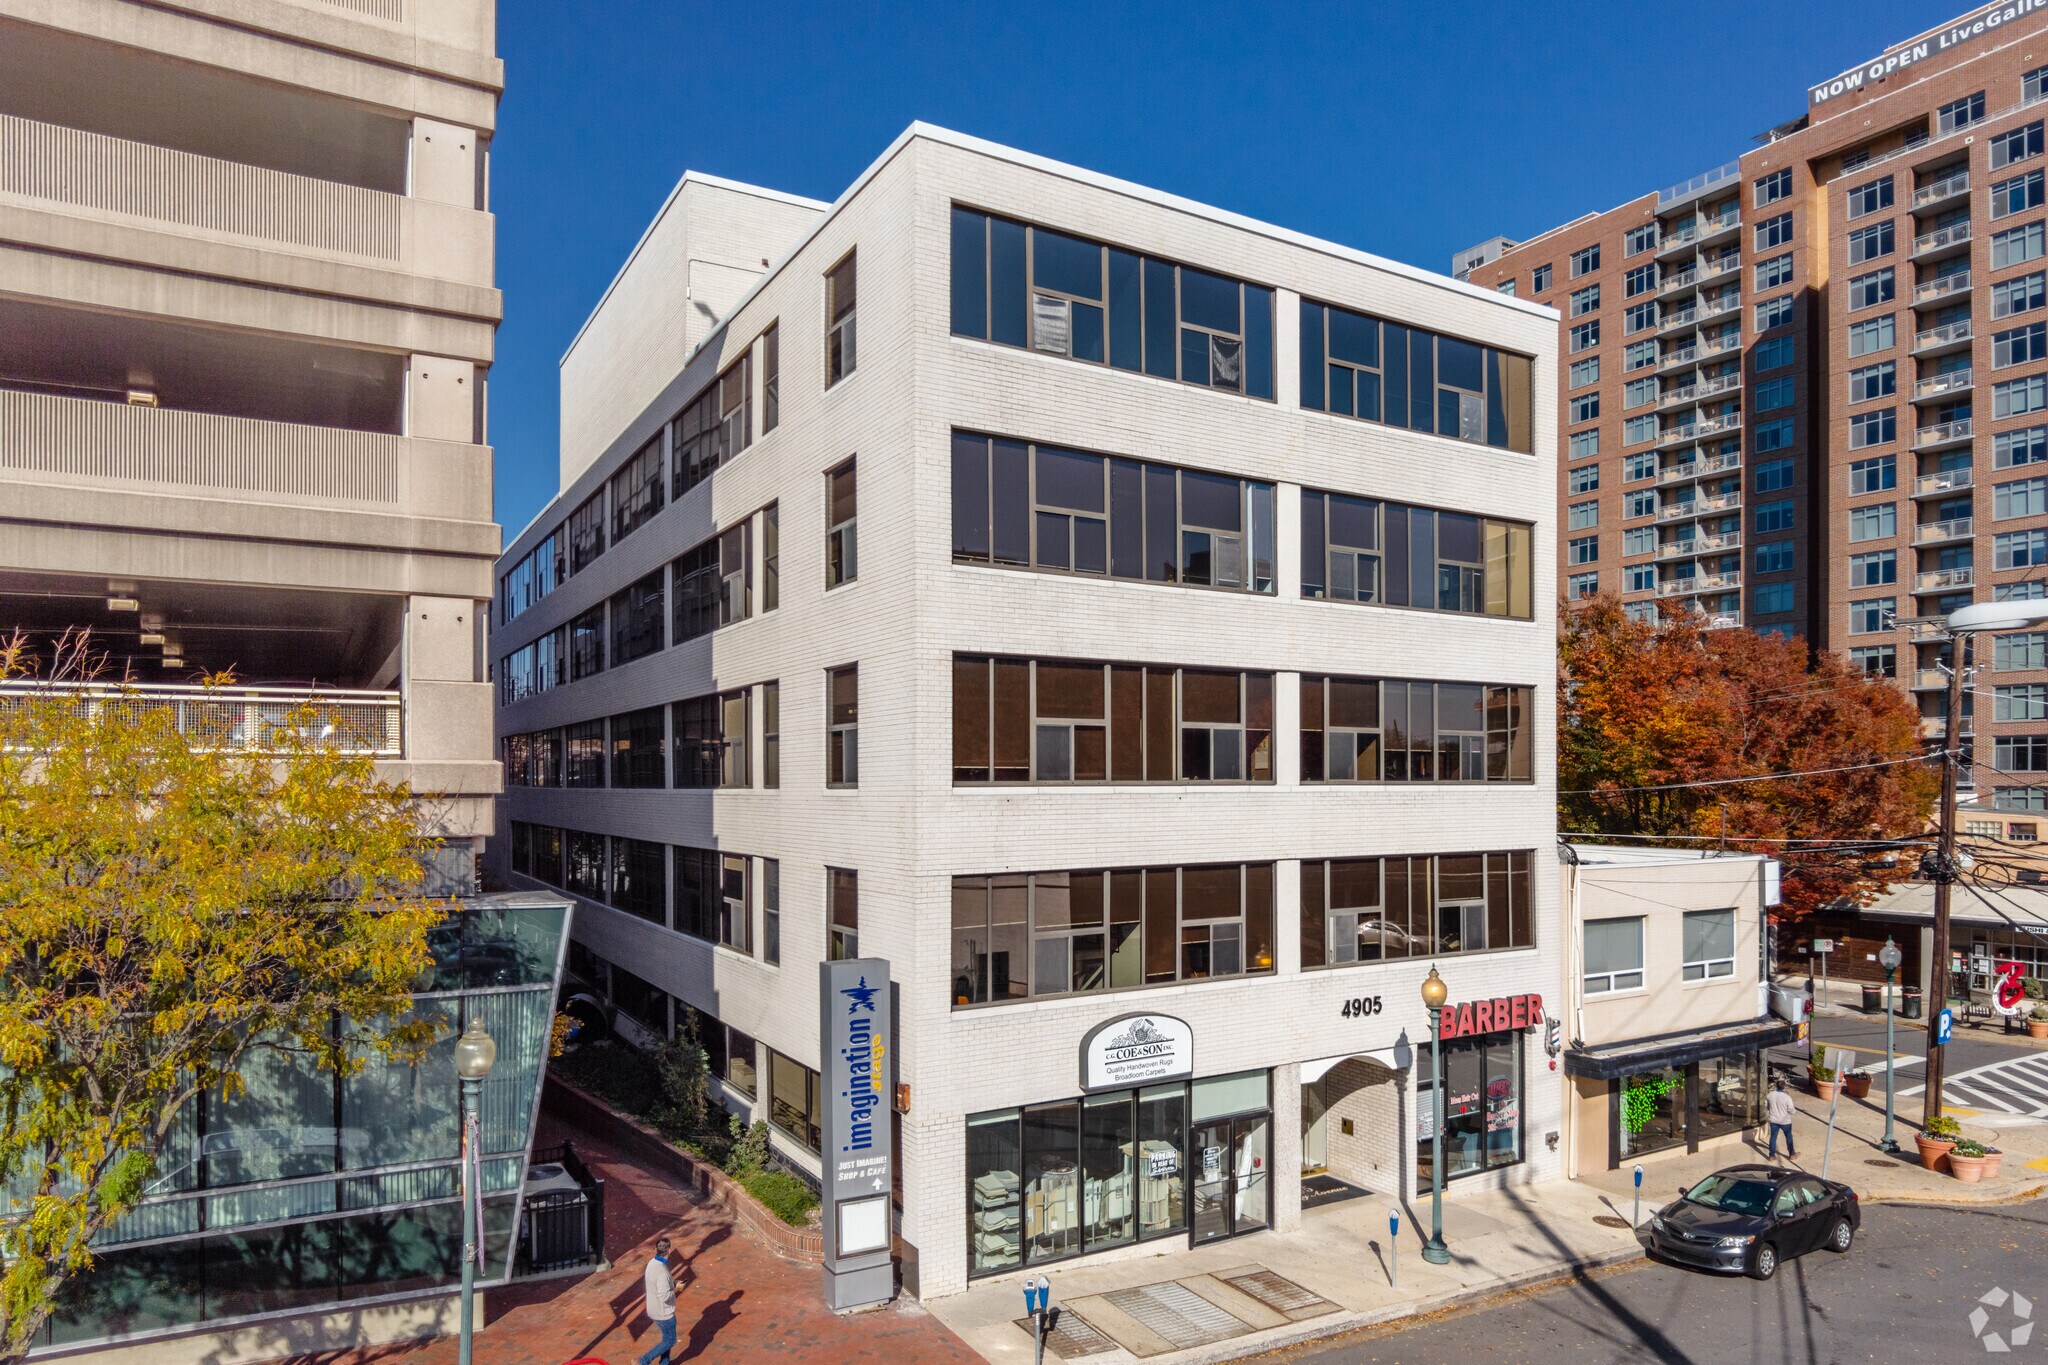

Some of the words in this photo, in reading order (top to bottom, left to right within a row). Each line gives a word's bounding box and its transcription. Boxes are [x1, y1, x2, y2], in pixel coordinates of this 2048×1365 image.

[1815, 71, 1863, 103] NOW
[1869, 43, 1928, 78] OPEN
[1342, 996, 1383, 1019] 4905
[1439, 993, 1543, 1040] BARBER
[1940, 1013, 1950, 1038] P
[872, 1033, 886, 1092] stage
[1106, 1066, 1126, 1075] Quality
[1127, 1061, 1158, 1071] Handwoven
[1160, 1059, 1173, 1067] Rugs
[1115, 1072, 1144, 1081] Broadloom
[1145, 1068, 1166, 1077] Carpets
[842, 1018, 879, 1152] imagination
[838, 1161, 855, 1171] JUST
